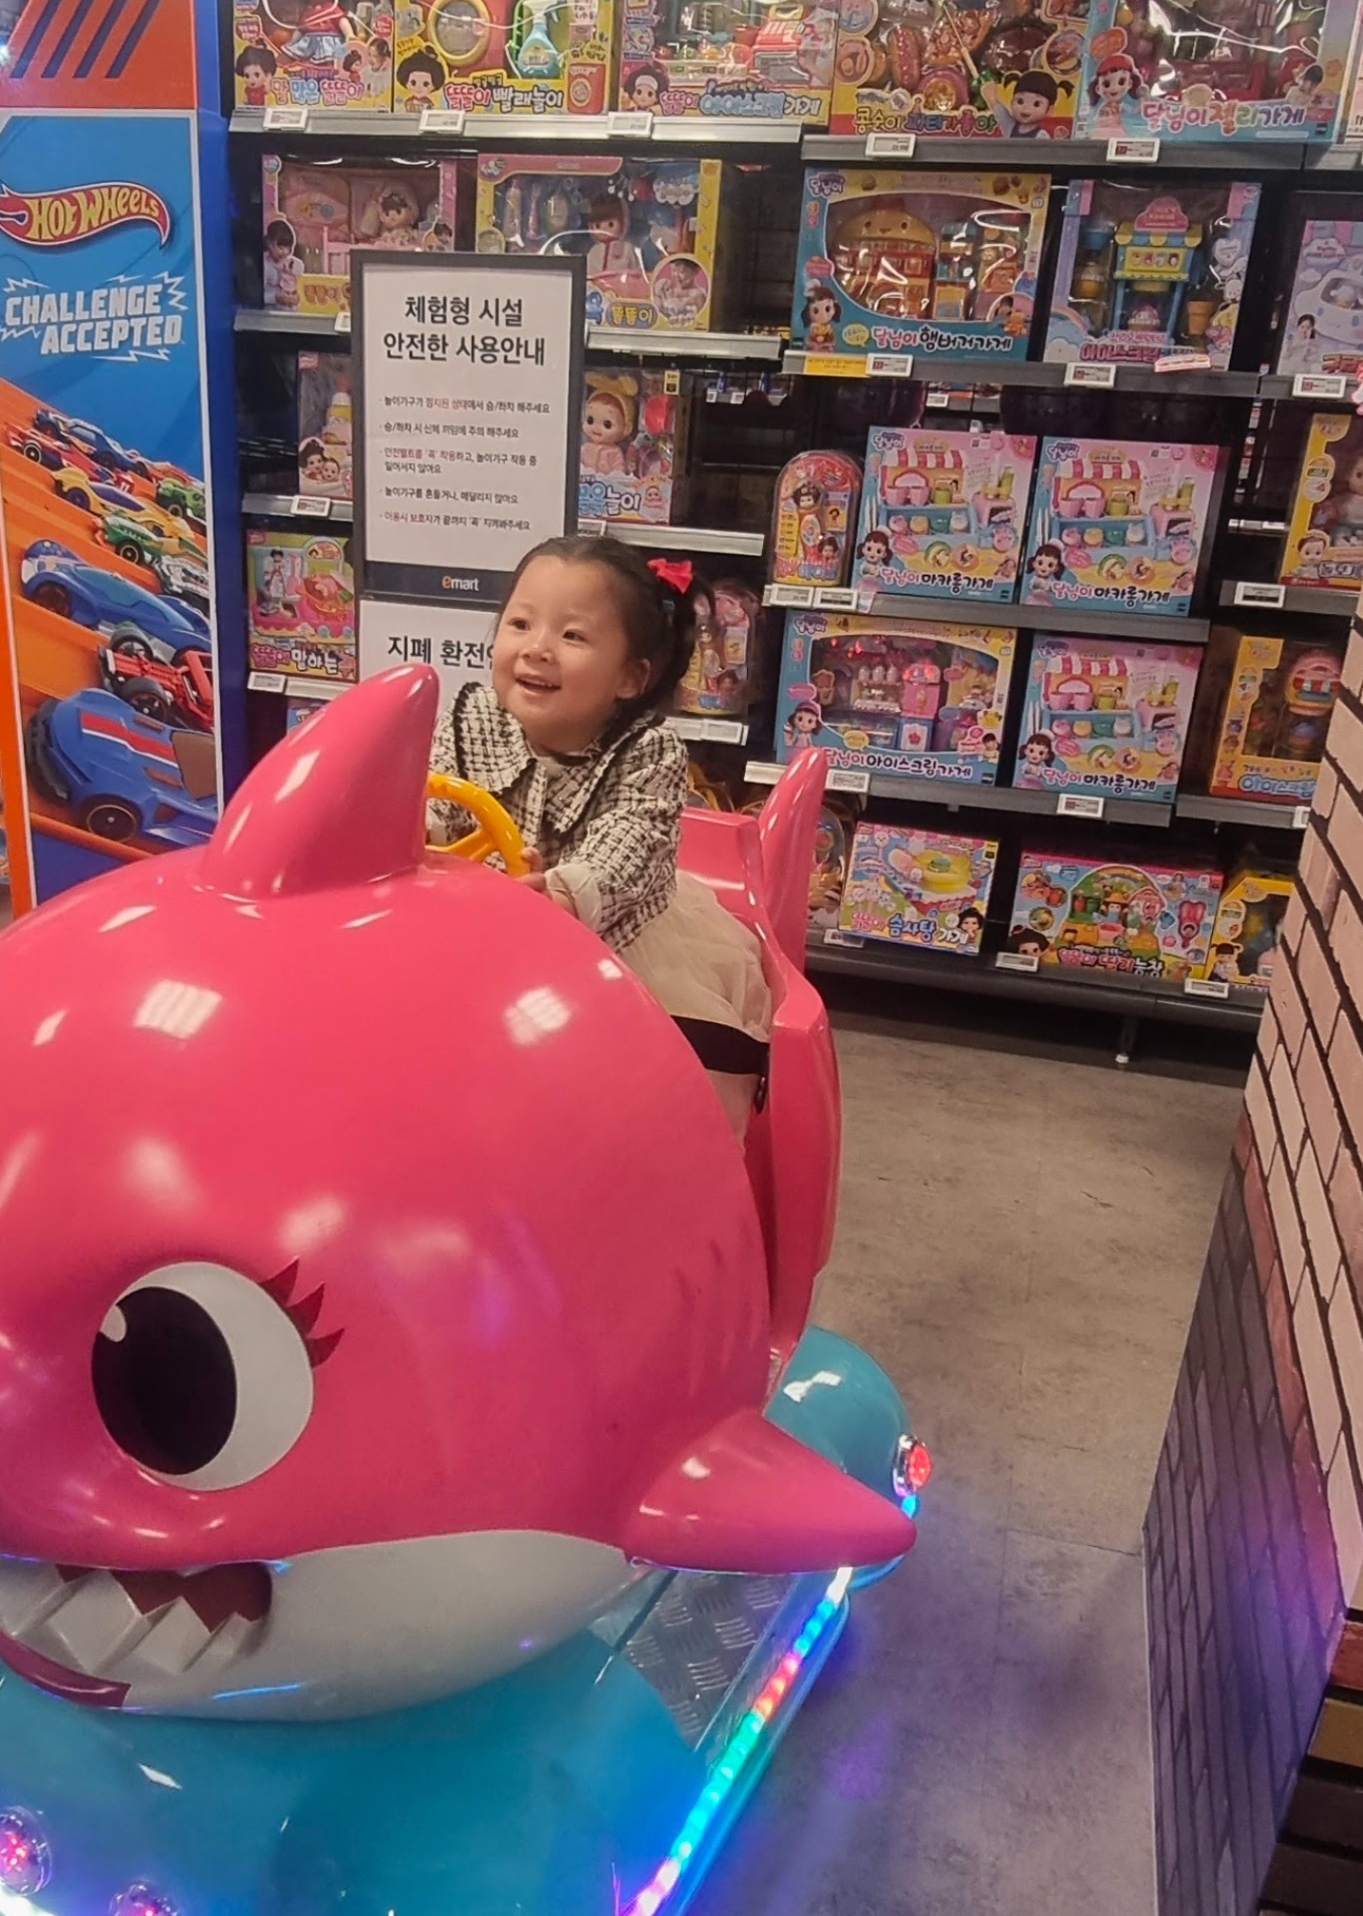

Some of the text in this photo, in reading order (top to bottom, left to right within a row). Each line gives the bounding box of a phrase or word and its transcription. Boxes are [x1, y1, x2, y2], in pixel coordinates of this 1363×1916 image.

[492, 85, 564, 114] 빨래놀이
[785, 96, 821, 116] 가게
[855, 106, 901, 134] 콩순이
[5, 284, 164, 326] CHALLENGE
[405, 295, 523, 328] 체험형 시설
[41, 315, 183, 355] ACCEPTED
[871, 326, 918, 349] 달님이
[918, 326, 1012, 353] 햄버거가게
[383, 332, 545, 366] 안전한 사용안내
[426, 397, 450, 409] 정지된
[451, 399, 485, 411] 상태에서
[516, 402, 551, 414] 해주세요
[414, 423, 422, 433] 시
[486, 426, 520, 439] 해주세요
[385, 486, 423, 499] 놀이기구를
[409, 513, 441, 526] 보호자가
[442, 575, 480, 592] emart
[880, 568, 994, 594] 달님이 마카롱가게
[1051, 580, 1171, 608] 달님이 마카롱가게
[290, 648, 341, 676] 말하는
[387, 635, 432, 665] 지폐
[866, 751, 972, 778] 아이스크림가게
[1042, 768, 1157, 794] 달님이 마카롱가게
[887, 913, 937, 943] 솜사탕
[937, 927, 970, 945] 가게
[1134, 957, 1165, 979] 농장
